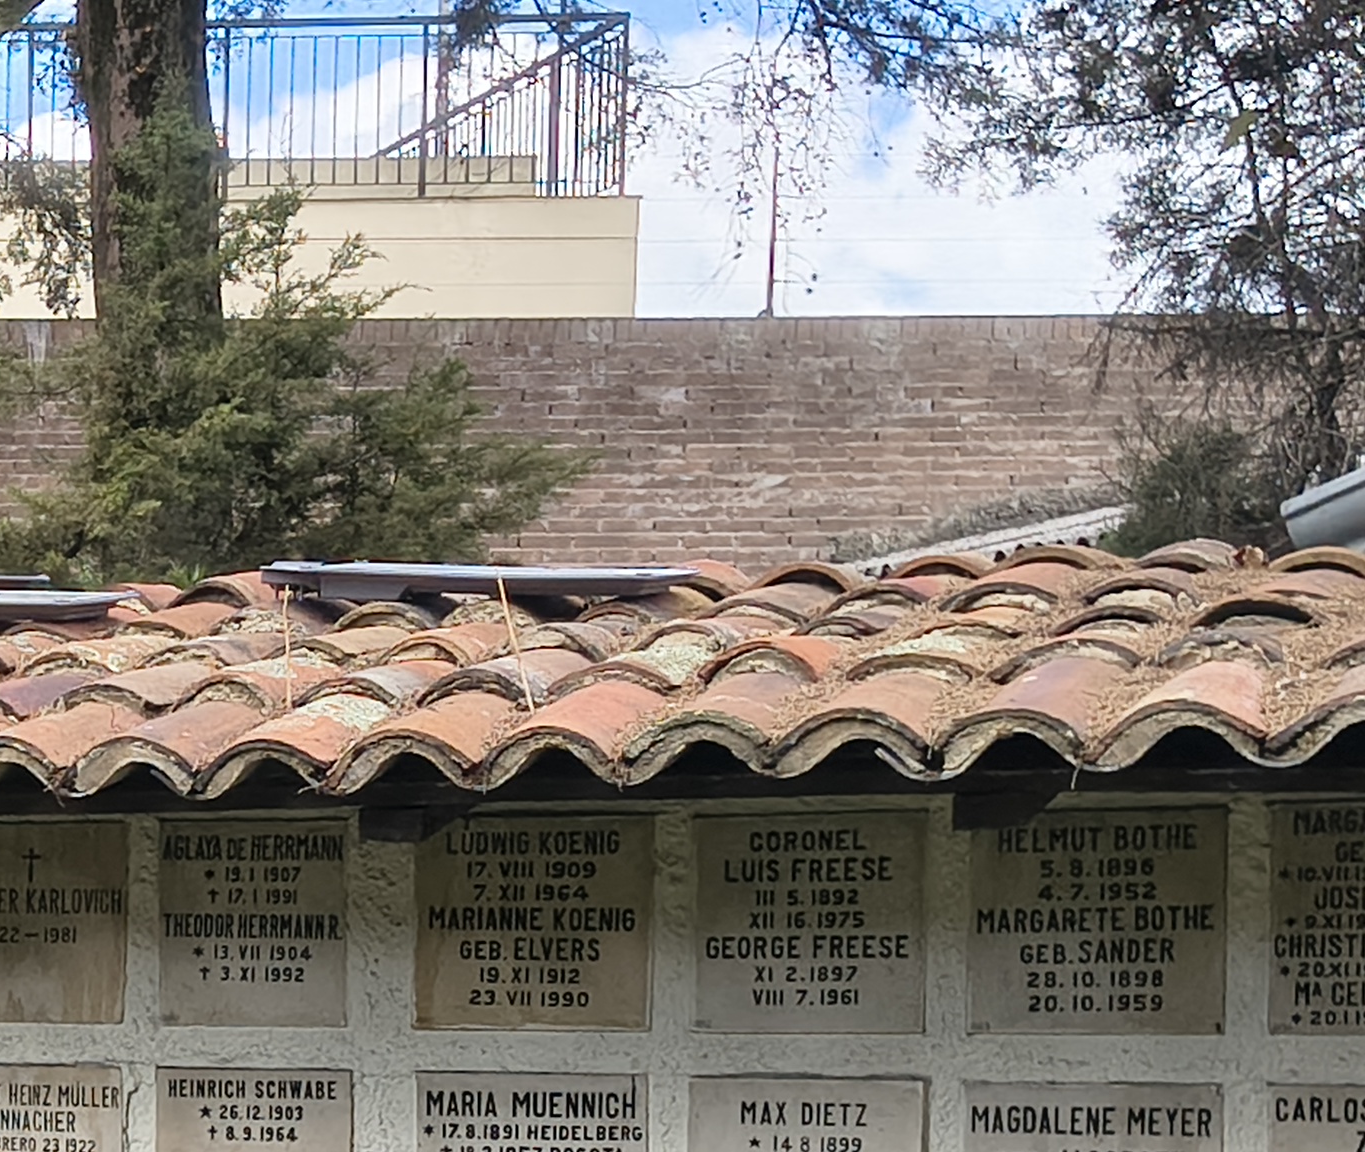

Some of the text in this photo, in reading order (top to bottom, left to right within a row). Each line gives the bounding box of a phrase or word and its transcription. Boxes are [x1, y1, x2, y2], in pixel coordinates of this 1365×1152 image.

[445, 829, 620, 856] LUDWIG KOENIG
[749, 828, 867, 853] CORONEL
[724, 855, 893, 884] LUIS FREESE
[976, 903, 1215, 935] MARGARETE BOTHE
[513, 936, 600, 962] ELVERS
[1078, 937, 1175, 964] SANDER
[8, 1082, 52, 1107] HEINZ
[57, 1081, 119, 1109] MÜLLER
[168, 1078, 337, 1100] HEINRICH SCHWABE
[426, 1090, 637, 1120] MARIA MUENNICH
[740, 1100, 867, 1127] MAX DIETZ
[526, 1124, 643, 1142] HEIDELBERG
[971, 1105, 1212, 1138] MAGDALENE MEYER
